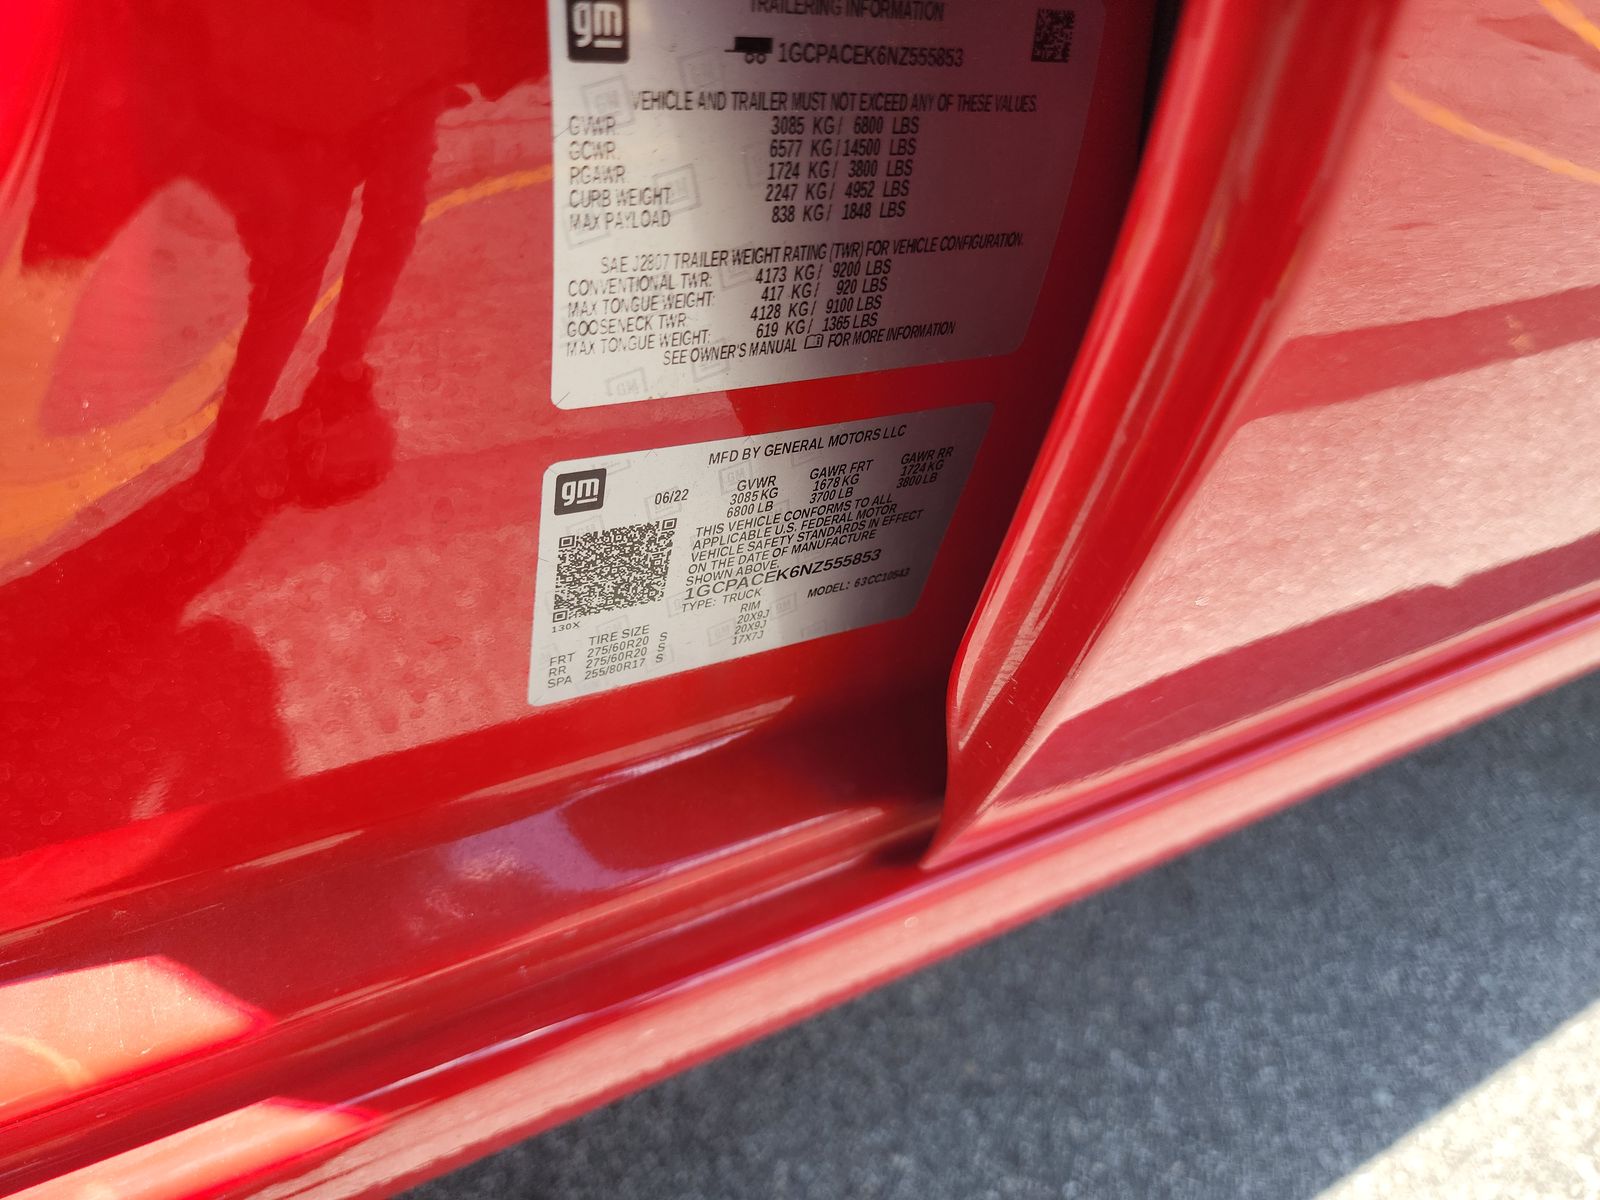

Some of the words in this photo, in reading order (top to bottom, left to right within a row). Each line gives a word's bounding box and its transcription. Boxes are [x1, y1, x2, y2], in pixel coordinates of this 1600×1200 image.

[846, 0, 943, 21] INFORMATION
[778, 42, 963, 67] 1GCPACEK6NZ555853
[632, 90, 693, 110] VEHICLE
[698, 91, 726, 111] AND
[731, 92, 787, 111] TRAILER
[792, 92, 827, 111] MUST
[831, 92, 856, 111] NOT
[859, 93, 907, 111] EXCEED
[911, 94, 934, 112] ANY
[937, 94, 953, 112] OF
[957, 94, 992, 112] THESE
[771, 116, 805, 135] 3085
[854, 116, 883, 134] 6800
[892, 117, 919, 134] LBS
[769, 139, 802, 158] 6577
[889, 138, 917, 156] LBS
[768, 162, 800, 180] 1724
[848, 160, 878, 178] 3800
[887, 159, 913, 177] LBS
[569, 190, 611, 208] CURB
[616, 187, 671, 206] WEIGHT
[766, 183, 798, 201] 2247
[844, 181, 875, 198] 4952
[883, 180, 910, 197] LBS
[569, 213, 599, 231] MAX
[605, 210, 671, 229] PAYLOAD
[771, 205, 795, 223] 838
[842, 202, 871, 220] 1848
[880, 201, 906, 218] LBS
[601, 256, 628, 274] SAE
[674, 250, 728, 269] TRAILER
[732, 246, 781, 265] WEIGHT
[783, 244, 827, 263] RATING
[829, 241, 864, 263] (TWR)
[865, 240, 890, 257] FOR
[893, 236, 939, 255] VEHICLE
[568, 273, 675, 297] CONVENTIONAL
[755, 266, 787, 284] 4173
[832, 261, 860, 278] 9200
[866, 259, 892, 276] LBS
[567, 302, 597, 318] MAX
[602, 296, 658, 315] TONGUE
[761, 286, 784, 301] 417
[836, 279, 857, 295] 920
[862, 277, 888, 294] LBS
[567, 315, 654, 337] GOOSENECK
[750, 303, 781, 321] 4128
[826, 298, 853, 314] 9100
[857, 295, 882, 311] LBS
[566, 340, 595, 356] MAX
[600, 334, 655, 353] TONGUE
[756, 322, 778, 338] 619
[822, 315, 850, 332] 1365
[853, 312, 878, 329] LBS
[663, 350, 687, 365] SEE
[690, 343, 746, 362] OWNER'S
[749, 338, 798, 357] MANUAL
[828, 333, 850, 348] FOR
[853, 328, 885, 345] MORE
[886, 321, 956, 342] INFORMATION
[709, 450, 738, 465] MFD
[742, 446, 761, 460] BY
[764, 437, 824, 457] GENERAL
[828, 428, 881, 447] MOTORS
[883, 424, 907, 439] LLC
[901, 449, 935, 465] GAWR
[937, 446, 954, 459] RR
[810, 464, 847, 479] GAWR
[850, 459, 874, 473] FRT
[900, 463, 926, 476] 1724
[927, 460, 944, 471] KG
[737, 475, 776, 492] GVWR
[813, 477, 840, 491] 1678
[841, 474, 860, 486] KG
[896, 475, 921, 489] 3800
[922, 472, 938, 484] LB
[561, 478, 600, 507] gm
[654, 488, 689, 505] 06/22
[730, 490, 759, 505] 3085
[760, 487, 779, 500] KG
[810, 489, 836, 504] 3700
[838, 487, 853, 499] LB
[696, 523, 724, 538] THIS
[728, 513, 781, 531] VEHICLE
[784, 500, 852, 521] CONFORMS
[855, 497, 870, 509] TO
[872, 493, 893, 506] ALL
[727, 503, 754, 518] 6800
[757, 501, 773, 513] LB
[691, 543, 744, 562] VEHICLE
[747, 534, 795, 552] SAFETY
[797, 520, 866, 542] STANDARDS
[868, 518, 879, 529] IN
[882, 509, 924, 526] EFFECT
[693, 527, 771, 550] APPLICABLE
[775, 522, 797, 535] U.S.
[801, 512, 853, 530] FEDERAL
[856, 503, 897, 520] MOTOR
[688, 562, 707, 575] ON
[712, 556, 735, 570] THE
[738, 550, 769, 565] DATE
[772, 546, 788, 558] OF
[791, 529, 877, 555] MANUFACTURE
[684, 549, 881, 600] 1GCPACEK6NZ555853
[686, 568, 733, 586] SHOWN
[736, 559, 779, 577] ABOVE.
[682, 597, 716, 612] TYPE:
[723, 587, 762, 604] TRUCK
[807, 581, 850, 598] MODEL:
[740, 600, 761, 613] RIM
[551, 621, 581, 633] 130X
[734, 620, 766, 635] 20X9J
[737, 609, 769, 624] 20X9J
[588, 631, 618, 646] TIRE
[621, 624, 650, 639] SIZE
[732, 631, 764, 645] 17X7J
[550, 652, 576, 666] FRT
[587, 636, 649, 658] 275/60R20
[659, 631, 668, 642] S
[547, 675, 573, 688] SPA
[584, 658, 646, 680] 255/80R17
[656, 653, 663, 663] S
[548, 666, 566, 678] RR
[586, 647, 647, 669] 275/60R20
[657, 643, 665, 653] S
